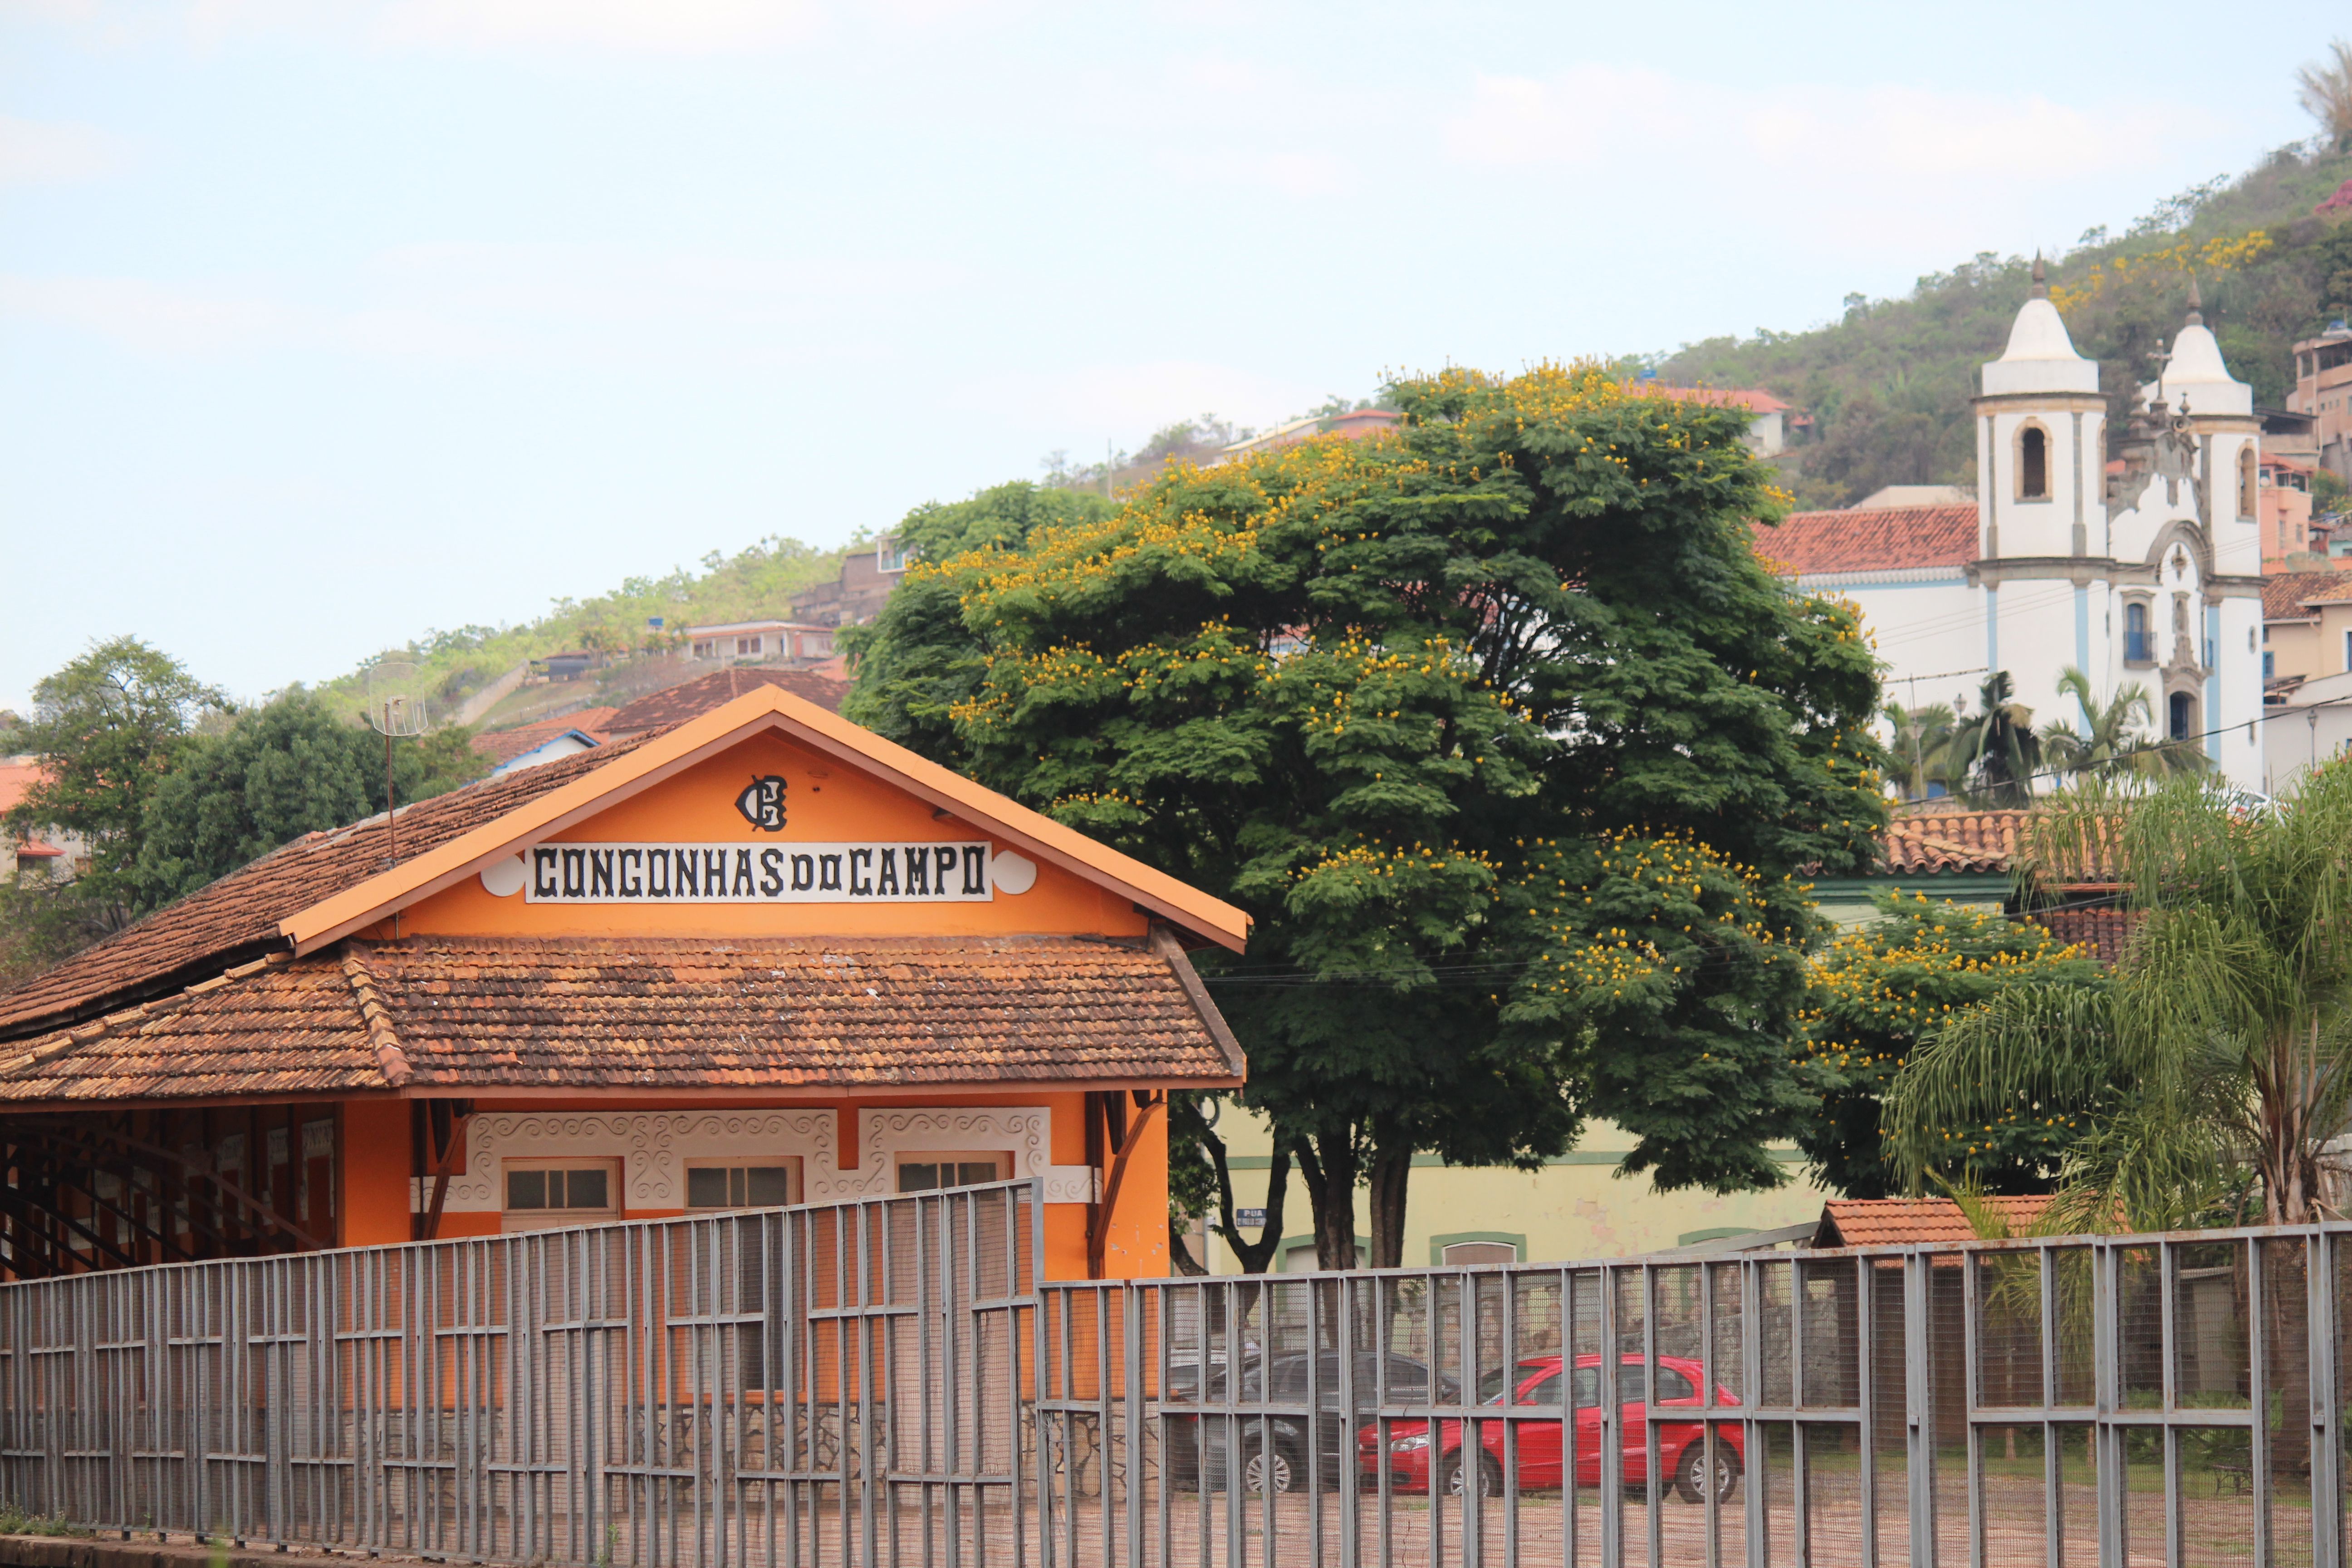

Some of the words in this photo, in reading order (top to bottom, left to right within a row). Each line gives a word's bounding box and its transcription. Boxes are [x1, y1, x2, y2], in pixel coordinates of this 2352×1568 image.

[534, 848, 784, 897] CONGONHAS
[791, 853, 843, 891] DO
[849, 846, 986, 896] CAMPO
